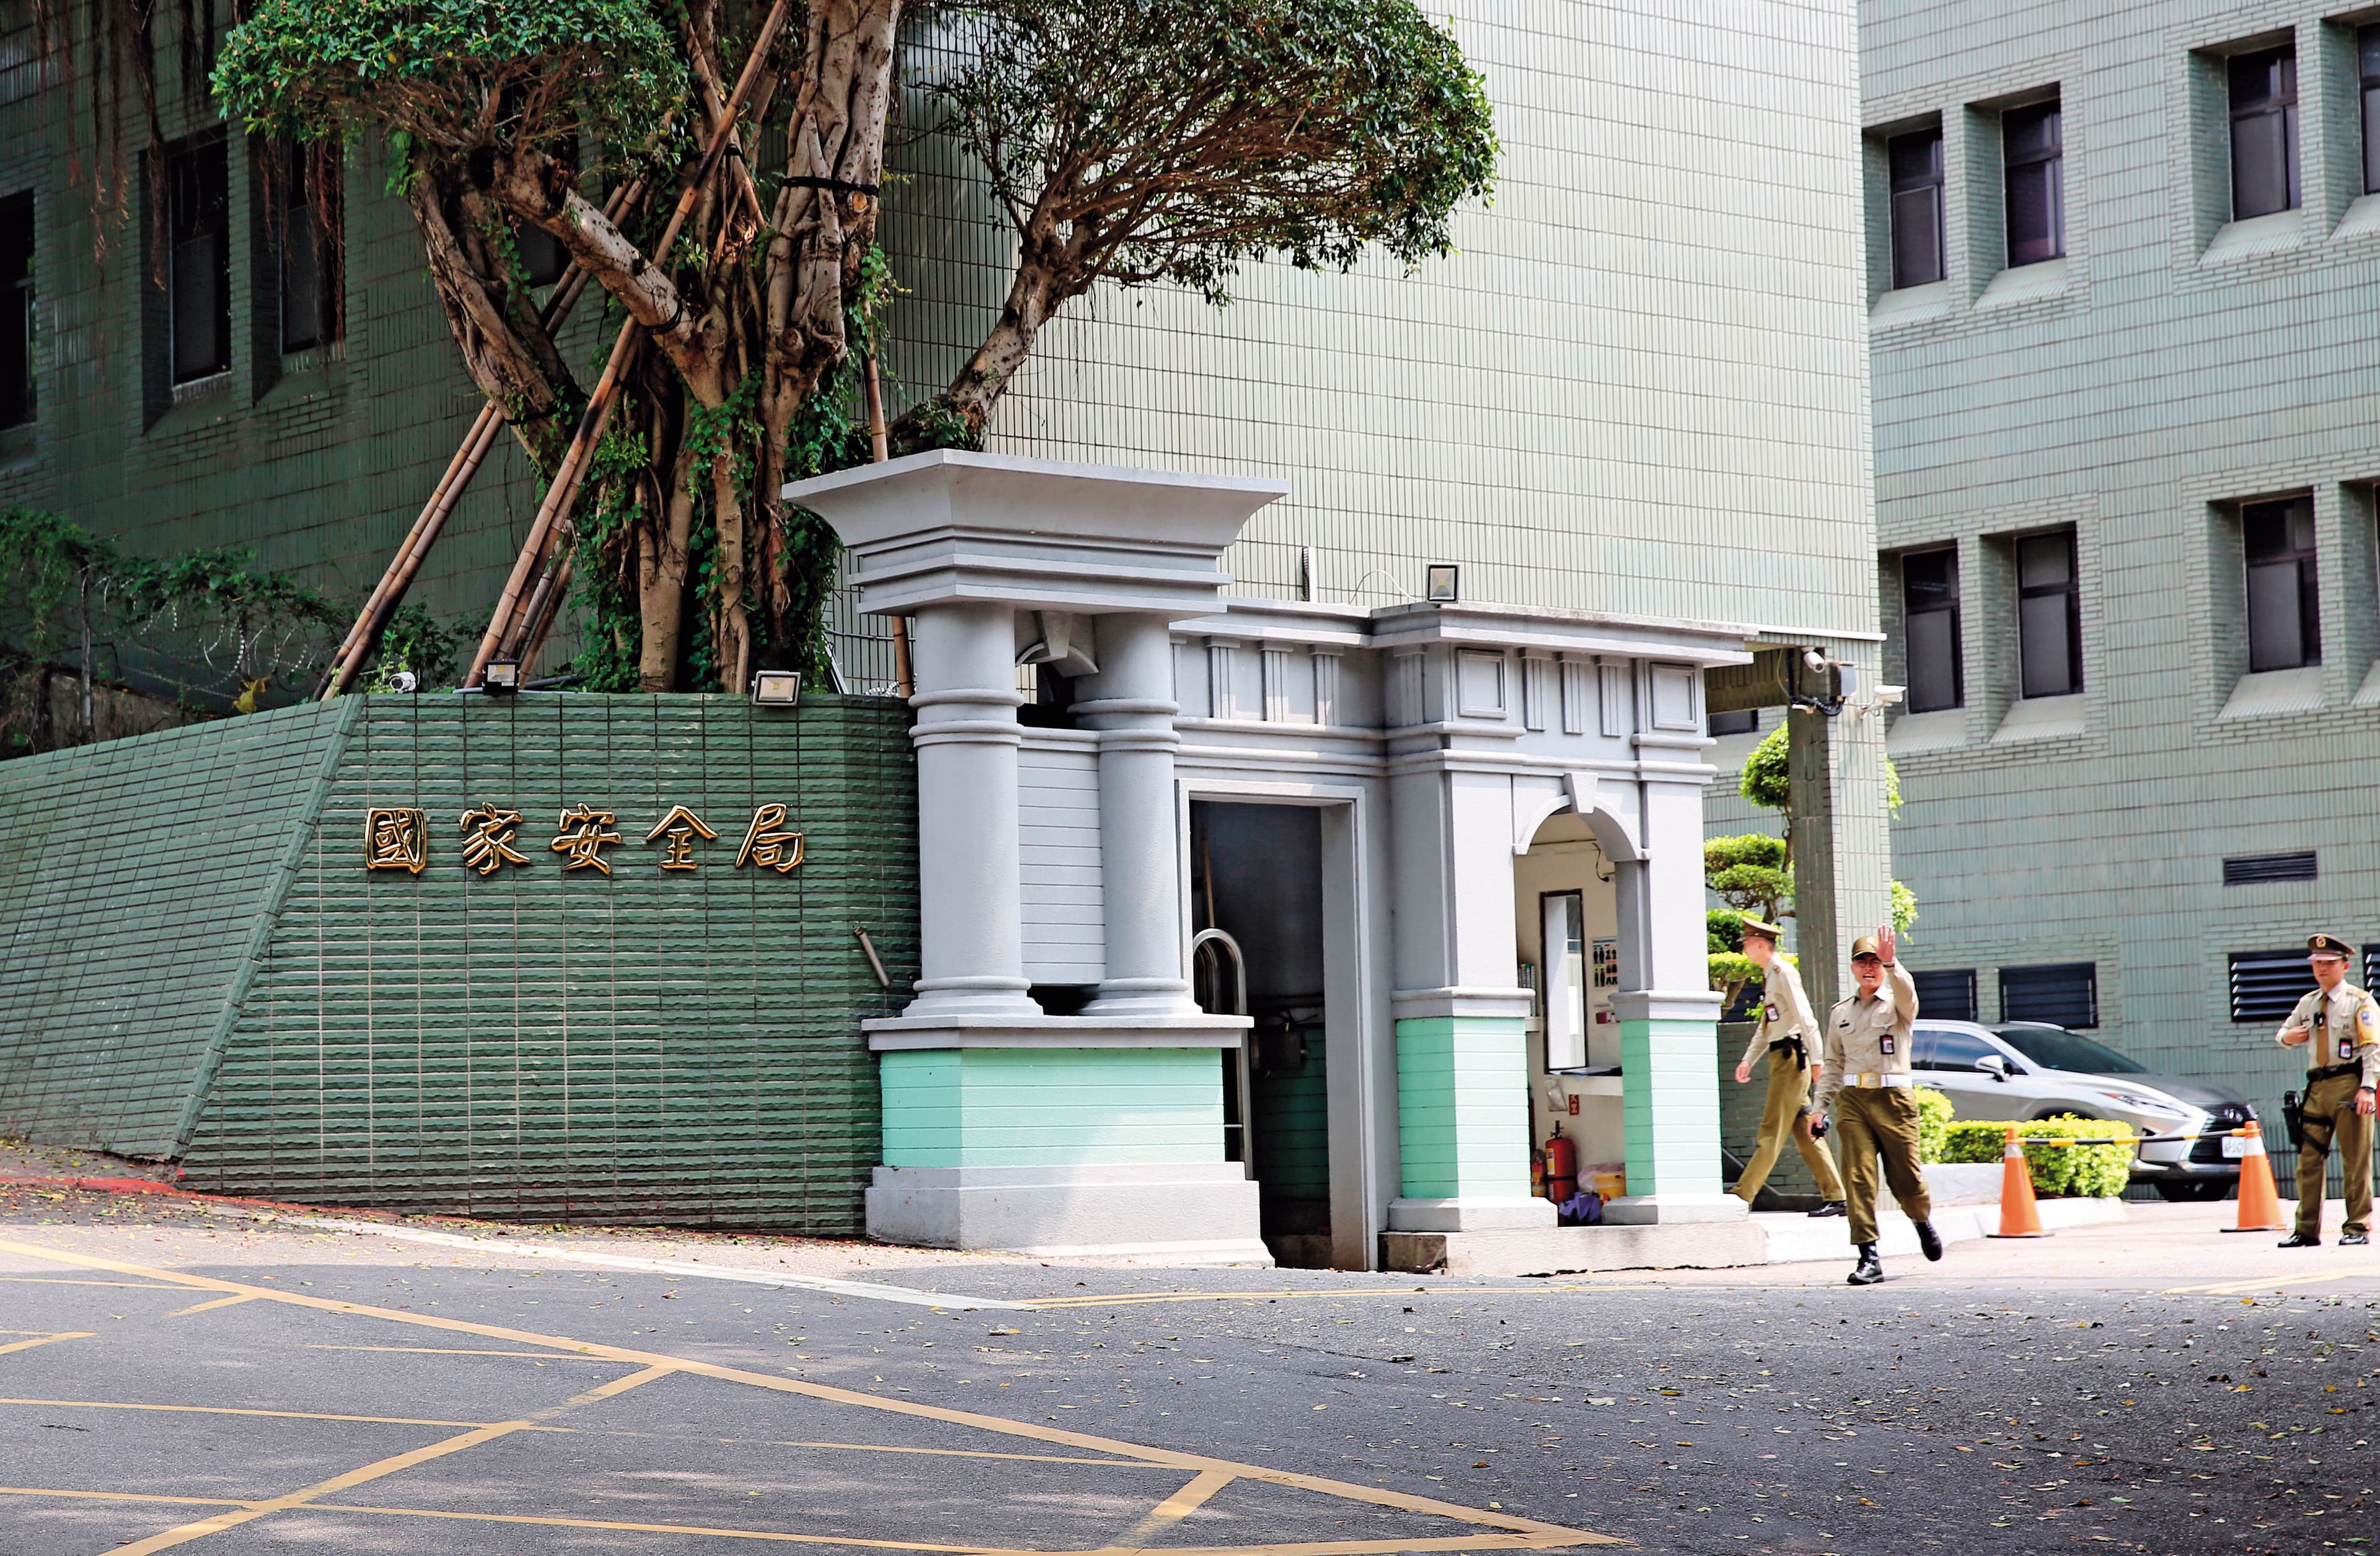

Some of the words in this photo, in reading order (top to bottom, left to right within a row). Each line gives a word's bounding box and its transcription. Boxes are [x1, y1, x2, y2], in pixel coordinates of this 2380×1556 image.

[364, 802, 805, 874] 國家安全局
